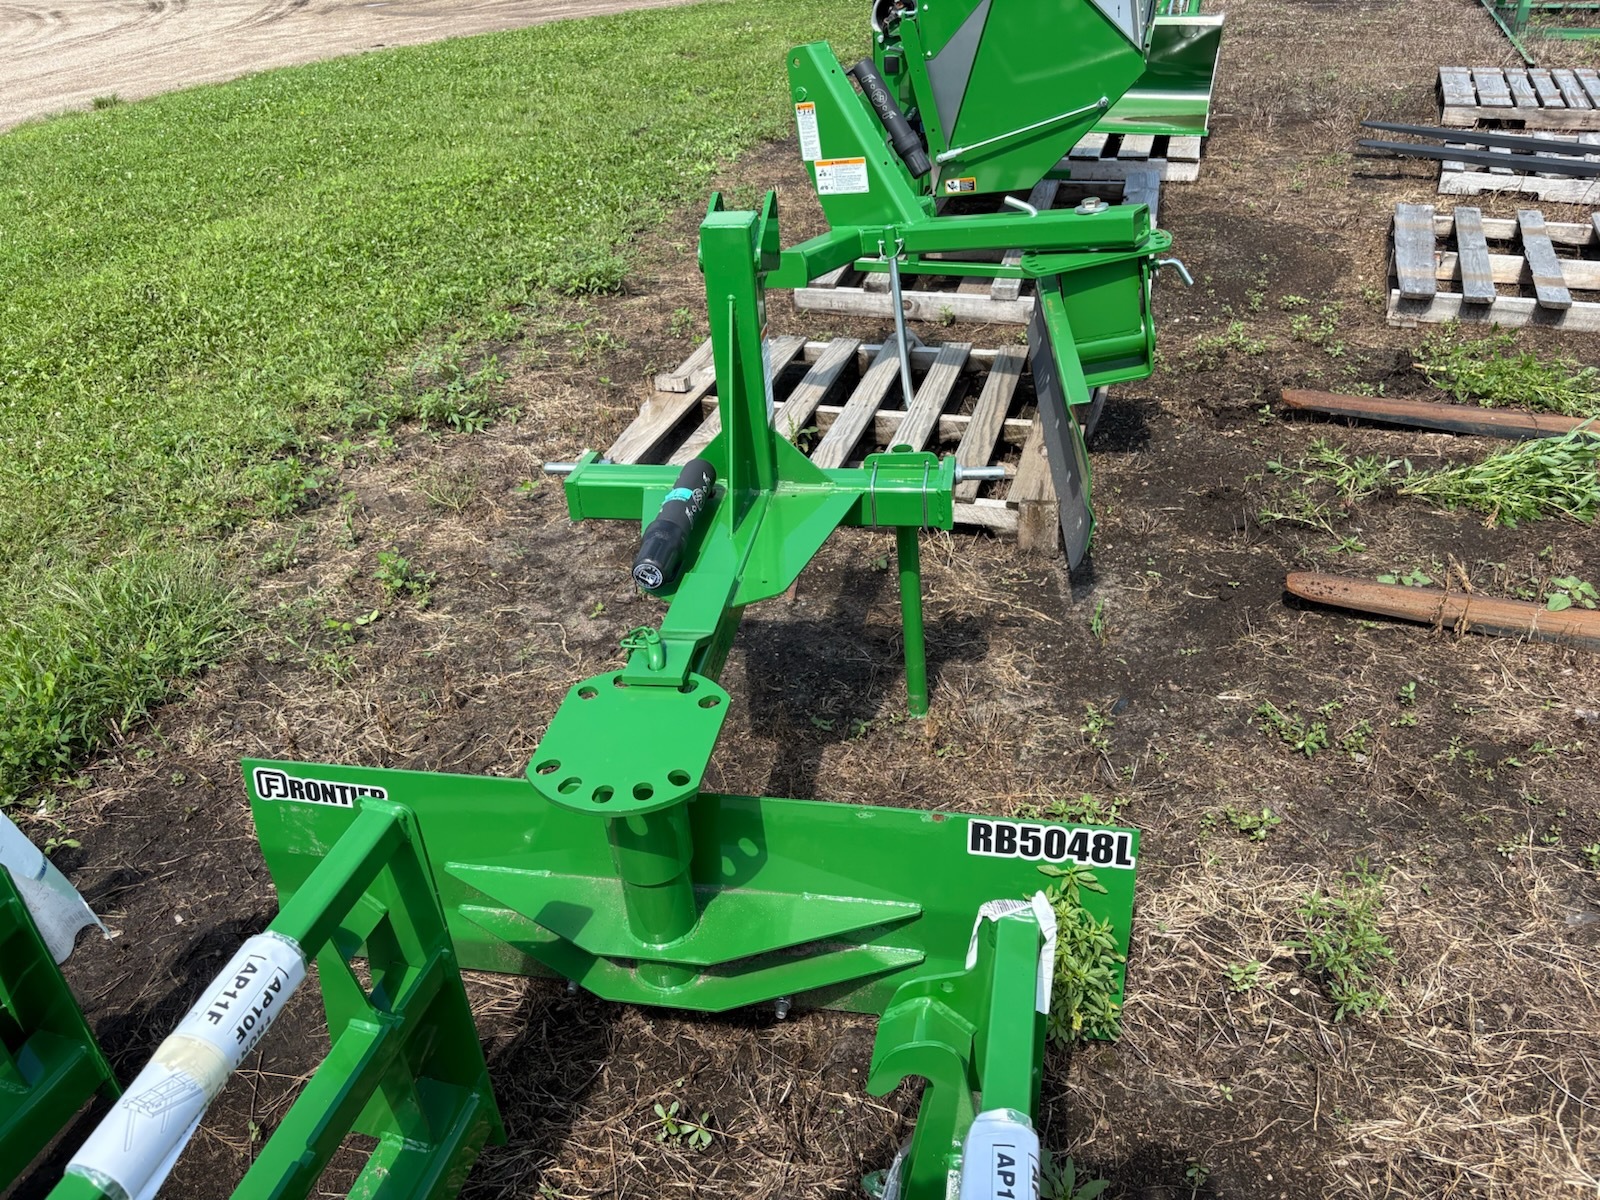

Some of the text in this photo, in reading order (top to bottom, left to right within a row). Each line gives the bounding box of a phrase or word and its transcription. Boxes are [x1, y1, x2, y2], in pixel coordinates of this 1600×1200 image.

[970, 821, 1132, 866] RB5048L
[207, 962, 259, 1026] AP11F
[235, 975, 282, 1045] AP10F
